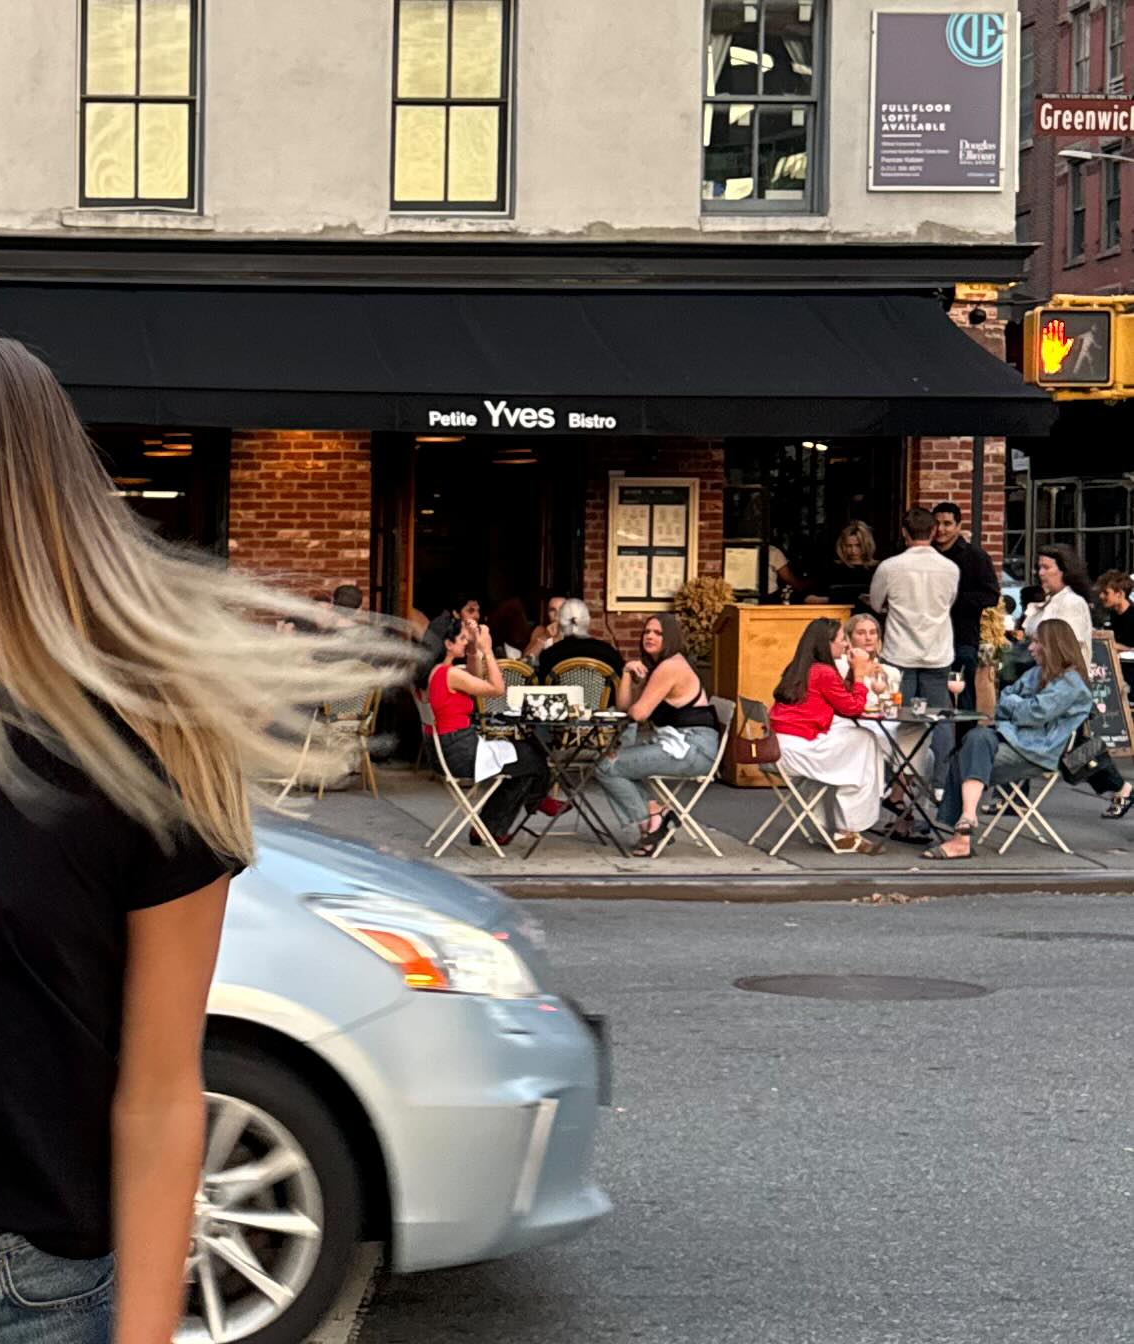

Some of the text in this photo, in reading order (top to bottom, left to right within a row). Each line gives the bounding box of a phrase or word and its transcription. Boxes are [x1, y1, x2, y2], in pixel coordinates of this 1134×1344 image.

[882, 104, 951, 112] FULL FLOOR
[882, 114, 917, 122] LOFTS
[1040, 102, 1134, 131] Greenwic
[882, 123, 946, 131] AVAILABLE
[428, 400, 616, 429] Petite Yves Bistro
